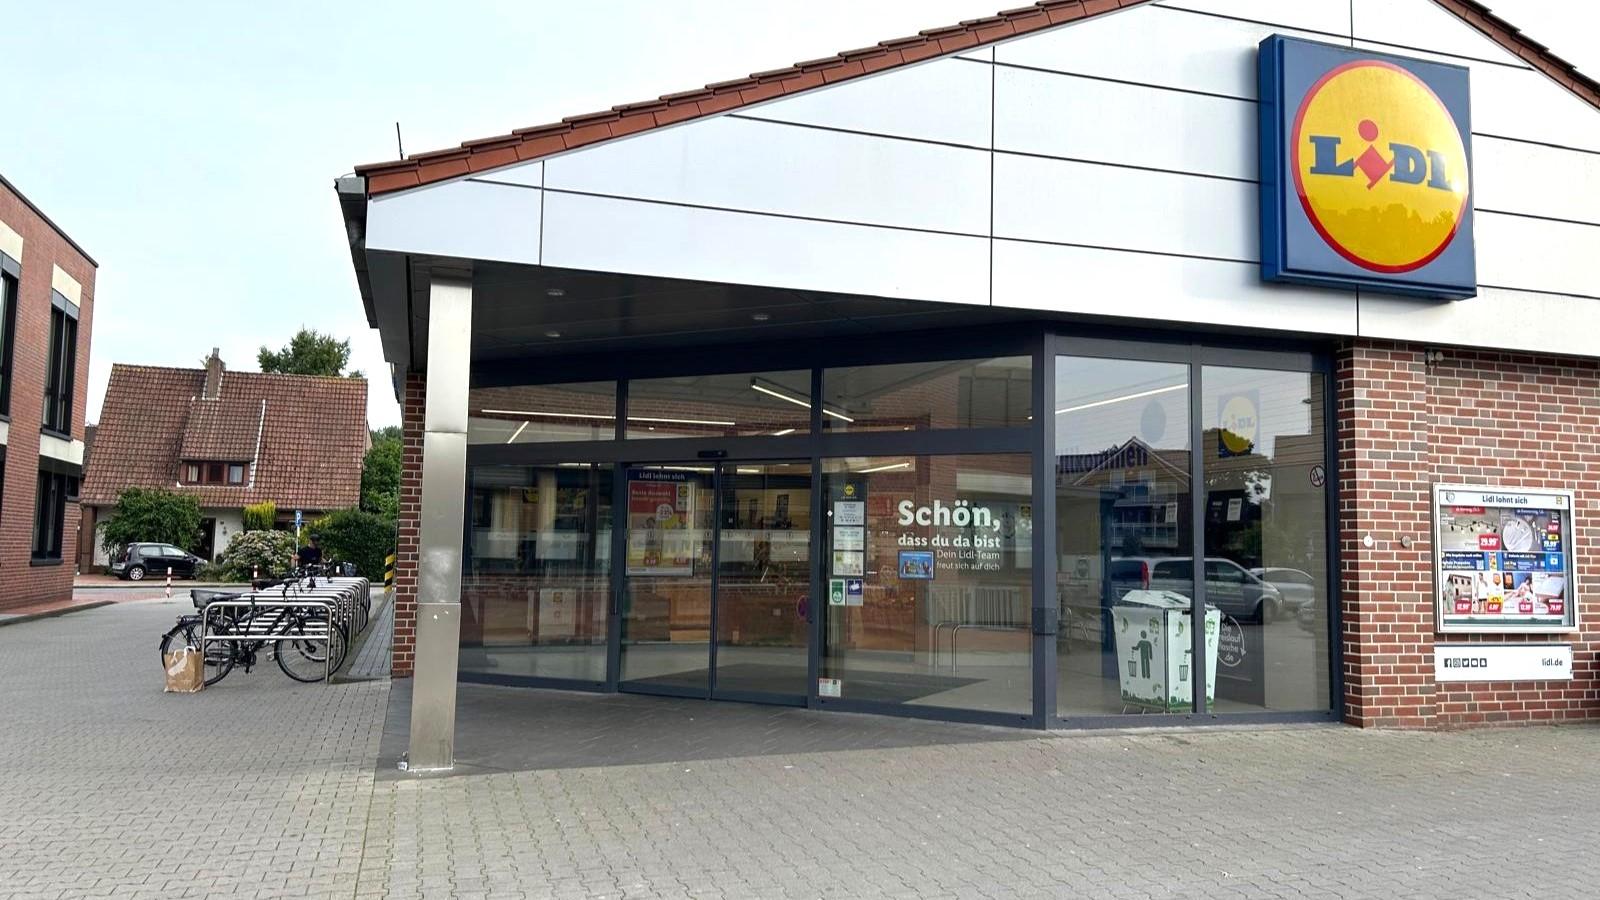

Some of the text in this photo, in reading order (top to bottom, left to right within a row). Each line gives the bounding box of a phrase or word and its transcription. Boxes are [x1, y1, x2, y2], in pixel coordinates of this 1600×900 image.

[1482, 495, 1528, 505] Lidl lohnt sich
[898, 499, 1000, 531] Schön,
[898, 533, 1001, 548] dass du da bist
[936, 549, 957, 559] Dein
[959, 550, 1001, 560] Lidl-Team
[936, 561, 1001, 571] freut sich auf dich
[1541, 658, 1563, 667] lidl.de
